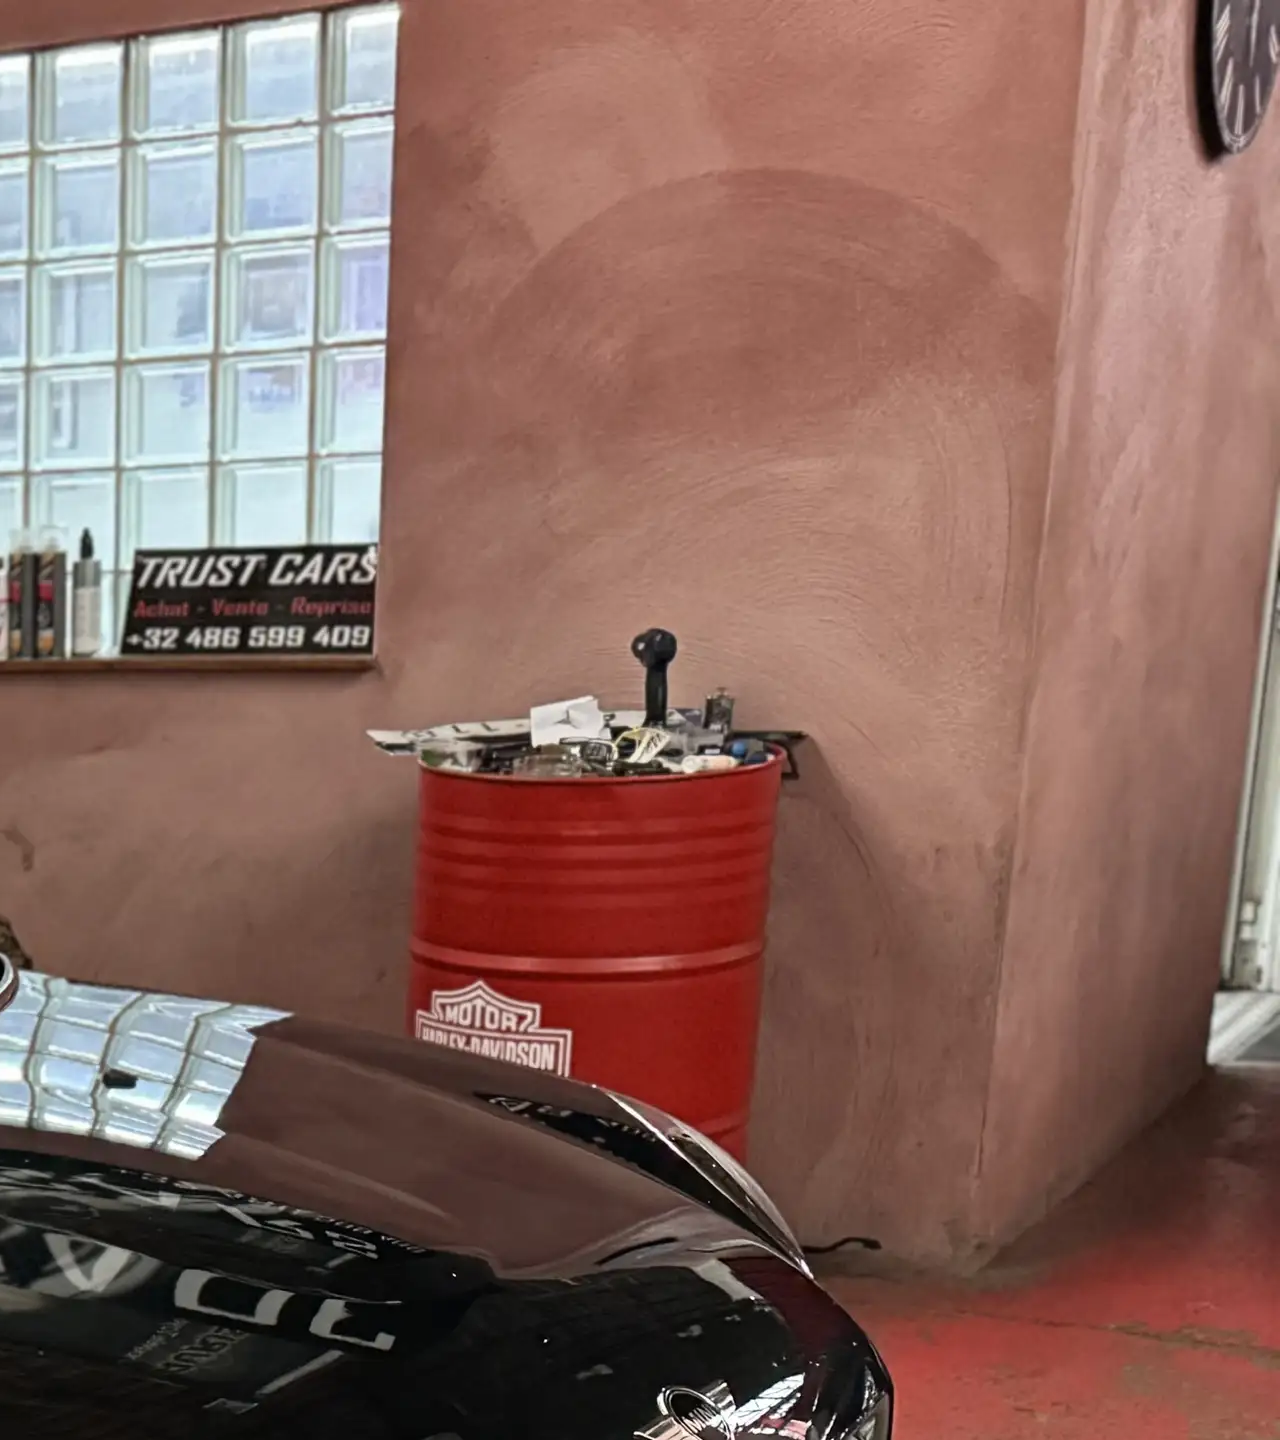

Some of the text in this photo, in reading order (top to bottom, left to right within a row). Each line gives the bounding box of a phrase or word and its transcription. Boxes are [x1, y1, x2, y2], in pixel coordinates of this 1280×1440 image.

[136, 552, 377, 588] TRUST CARS
[134, 600, 189, 618] Achat
[212, 599, 268, 617] Vente
[126, 625, 371, 650] +32 486 599 409
[445, 998, 518, 1032] MOTOR
